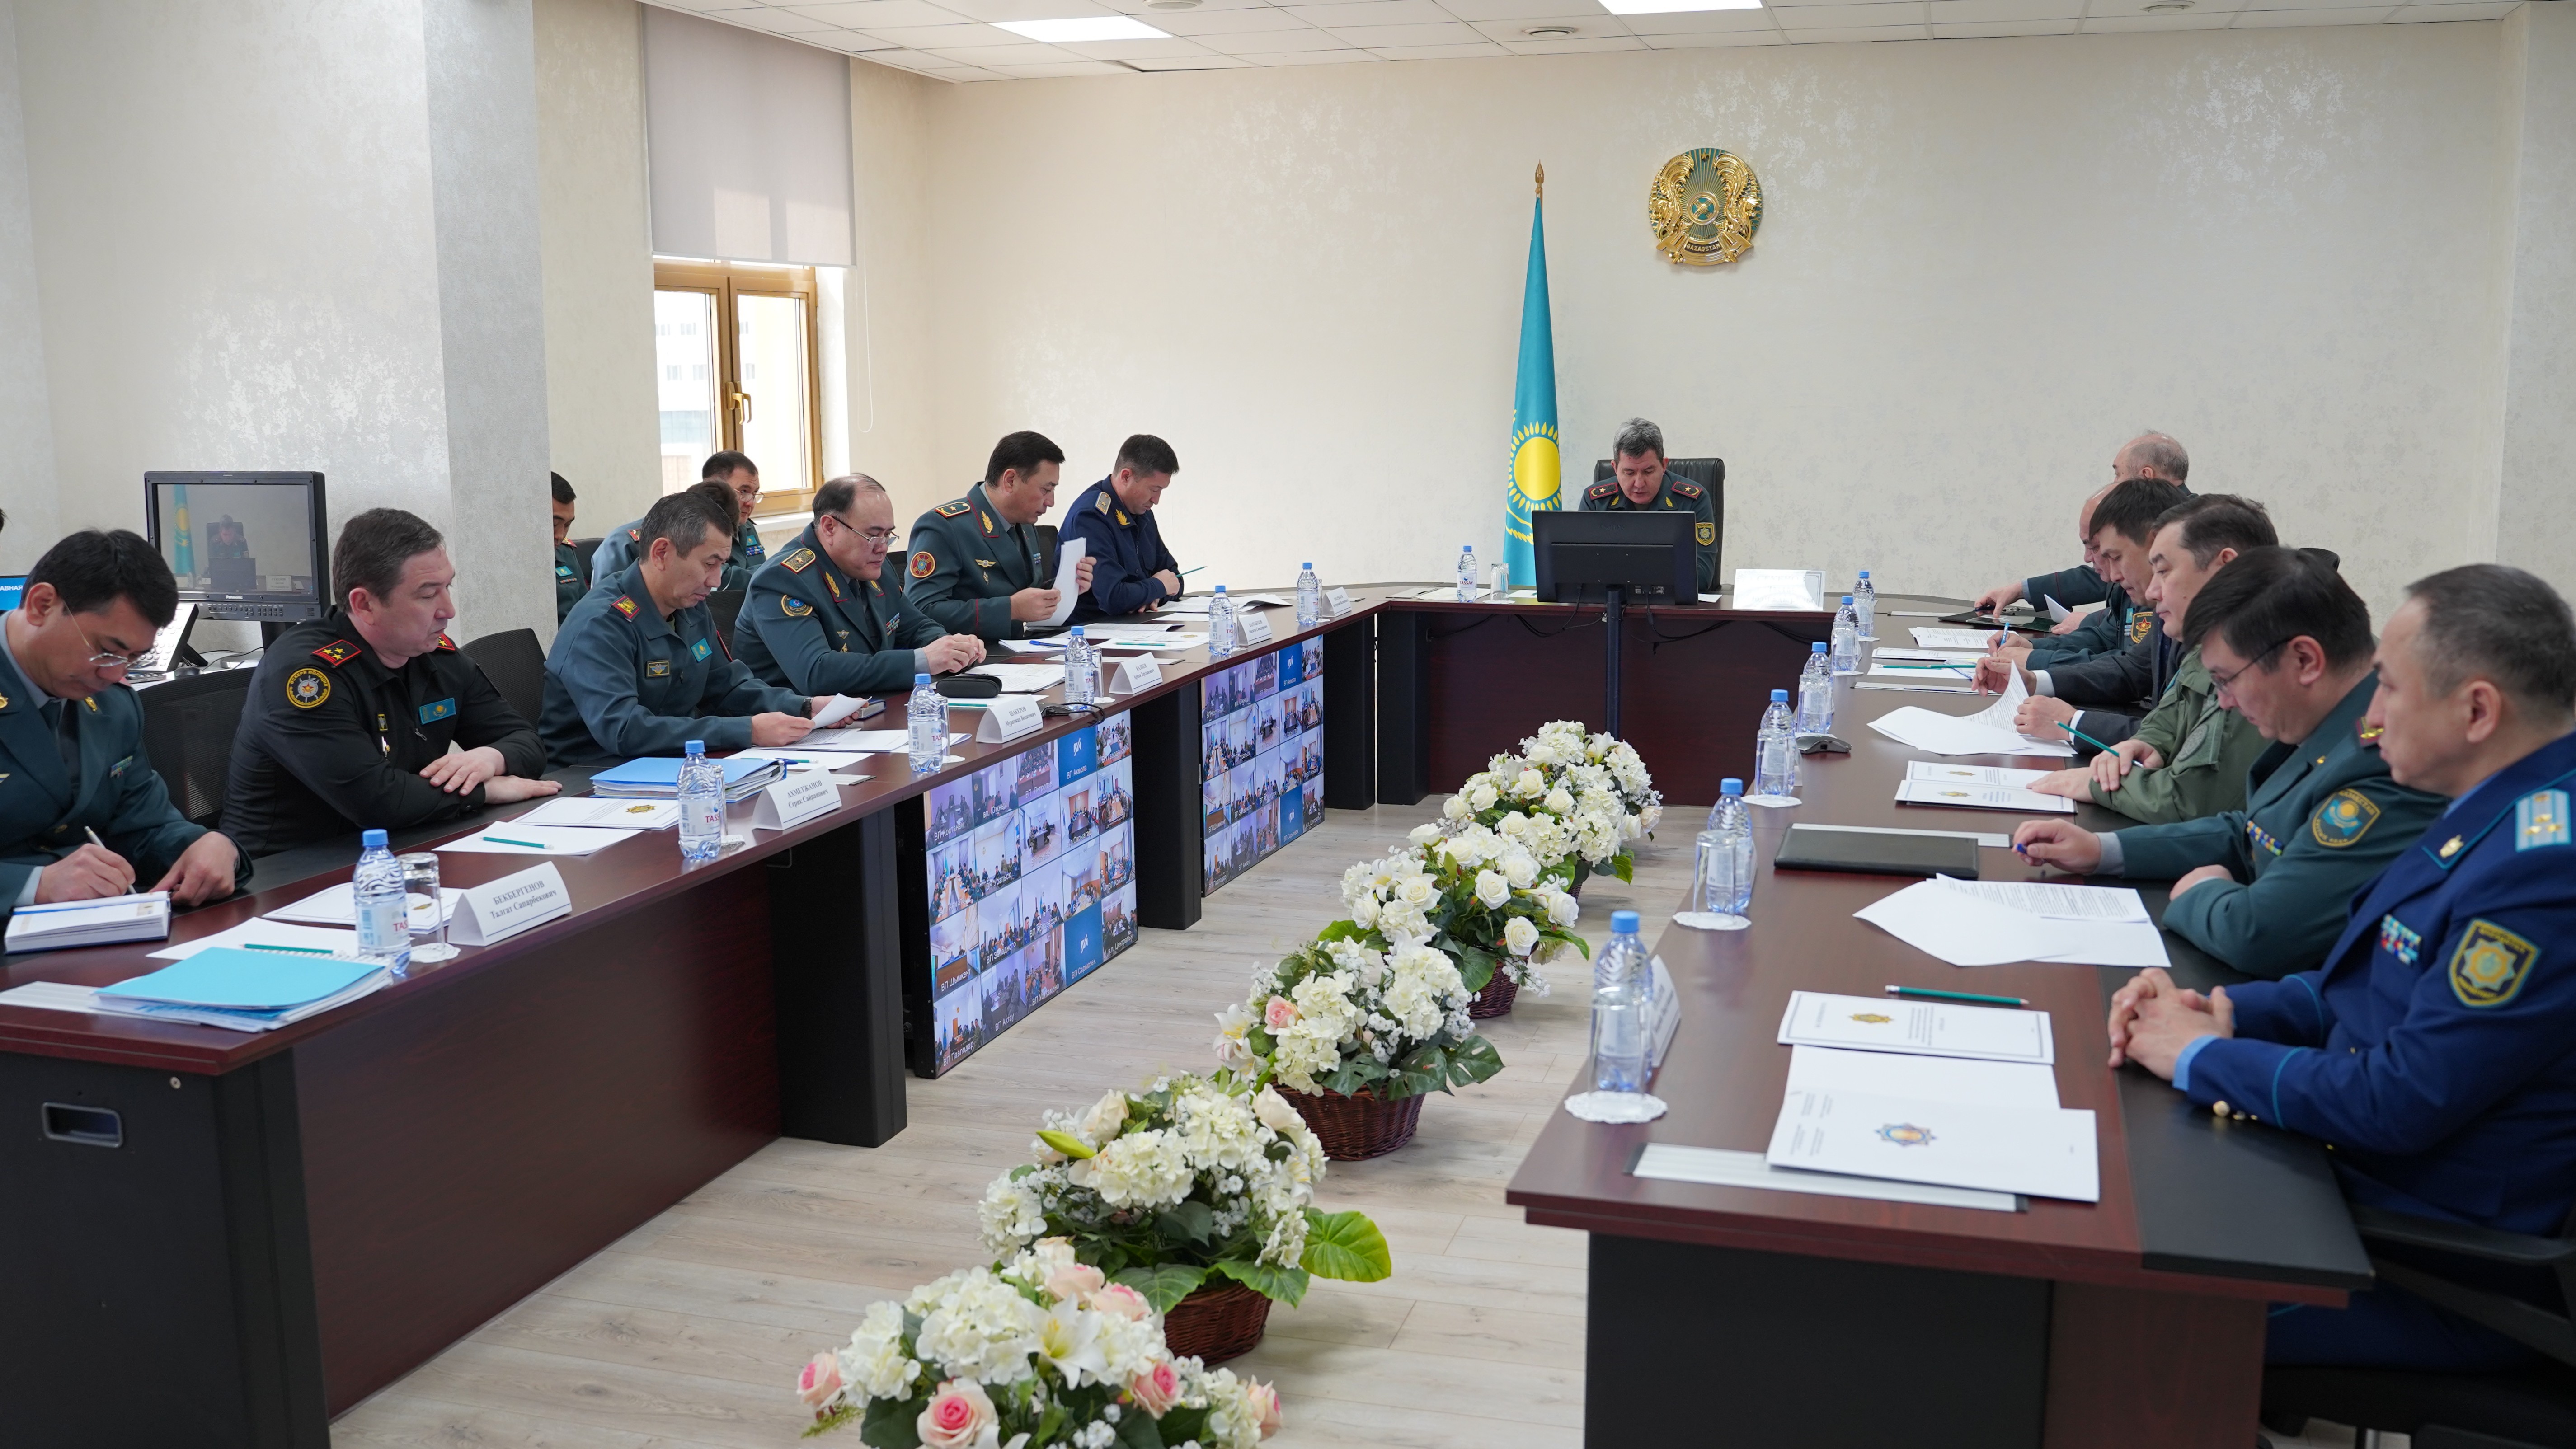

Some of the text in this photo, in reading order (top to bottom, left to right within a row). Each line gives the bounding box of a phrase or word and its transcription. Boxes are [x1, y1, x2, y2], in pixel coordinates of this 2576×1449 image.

[1686, 240, 1721, 253] QAZAQSTAN
[1067, 765, 1087, 779] ВП Акмола
[787, 780, 823, 798] АХМЕТЖАНОВ
[788, 789, 829, 808] Серик Сайранович
[493, 881, 545, 905] БЕКБЕРГЕНОВ
[489, 890, 557, 919] Талгат Сапарбекович
[987, 954, 993, 964] ВП
[941, 968, 971, 992] ВП Шымкент
[1072, 970, 1077, 979] ВП
[1032, 996, 1039, 1006] ВП
[995, 1013, 1015, 1031] ВП Актау
[943, 1041, 974, 1067] ВП Павлодар
